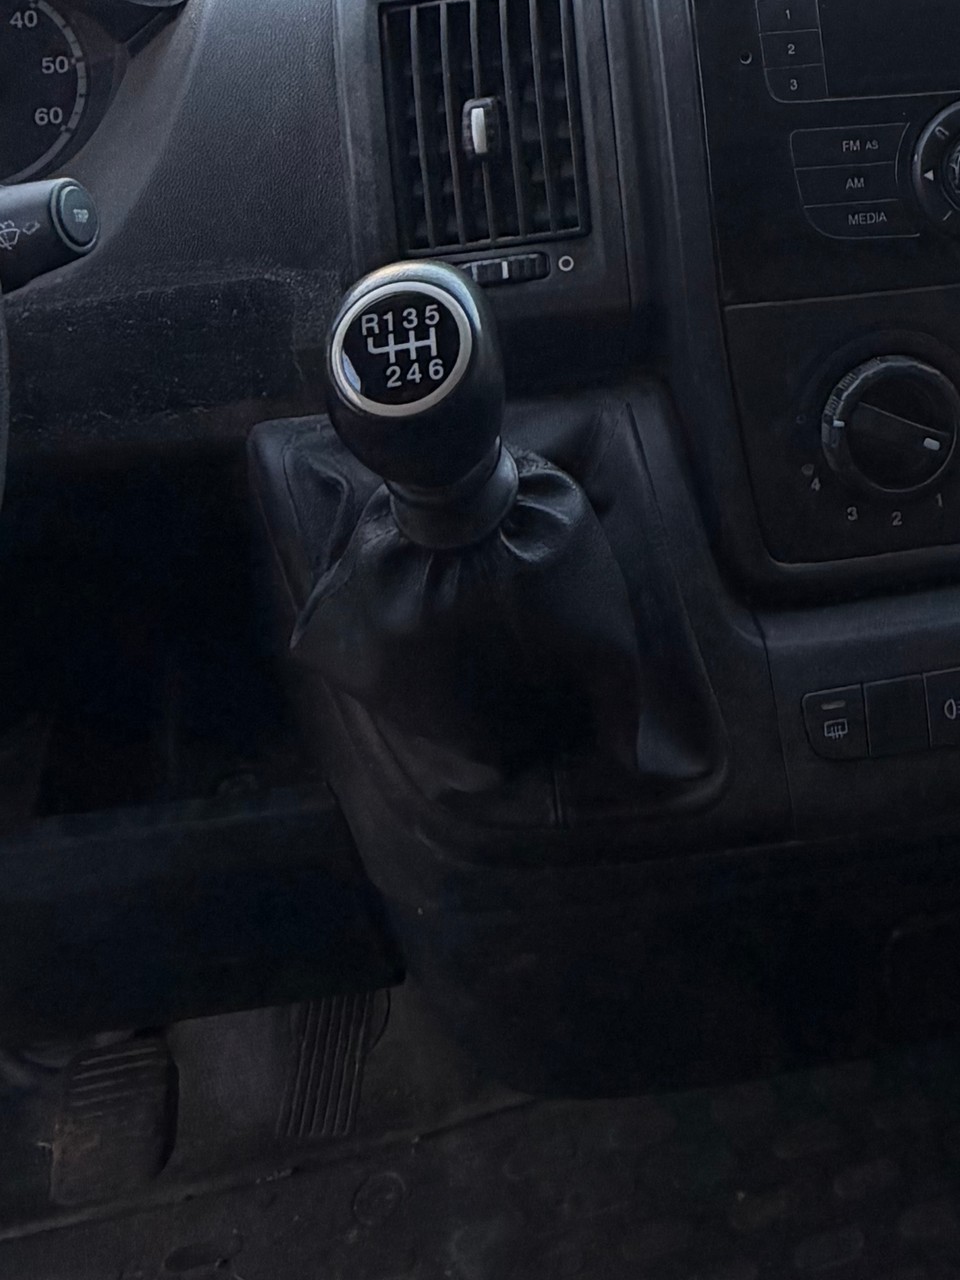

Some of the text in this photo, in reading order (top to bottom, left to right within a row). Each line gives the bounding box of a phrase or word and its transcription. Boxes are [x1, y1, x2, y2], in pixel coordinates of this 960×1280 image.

[9, 10, 38, 28] 40
[784, 8, 791, 21] 1
[787, 43, 796, 56] 2
[41, 56, 69, 74] 50
[789, 78, 798, 91] 3
[34, 107, 63, 126] 60
[842, 139, 879, 153] FM AS
[845, 176, 865, 189] AM
[847, 210, 888, 226] MEDIA
[361, 304, 440, 336] R 1 3 5
[386, 358, 444, 388] 2 4 6
[810, 479, 821, 491] 4
[936, 493, 944, 507] 1
[847, 506, 858, 521] 3
[892, 512, 903, 526] 2
